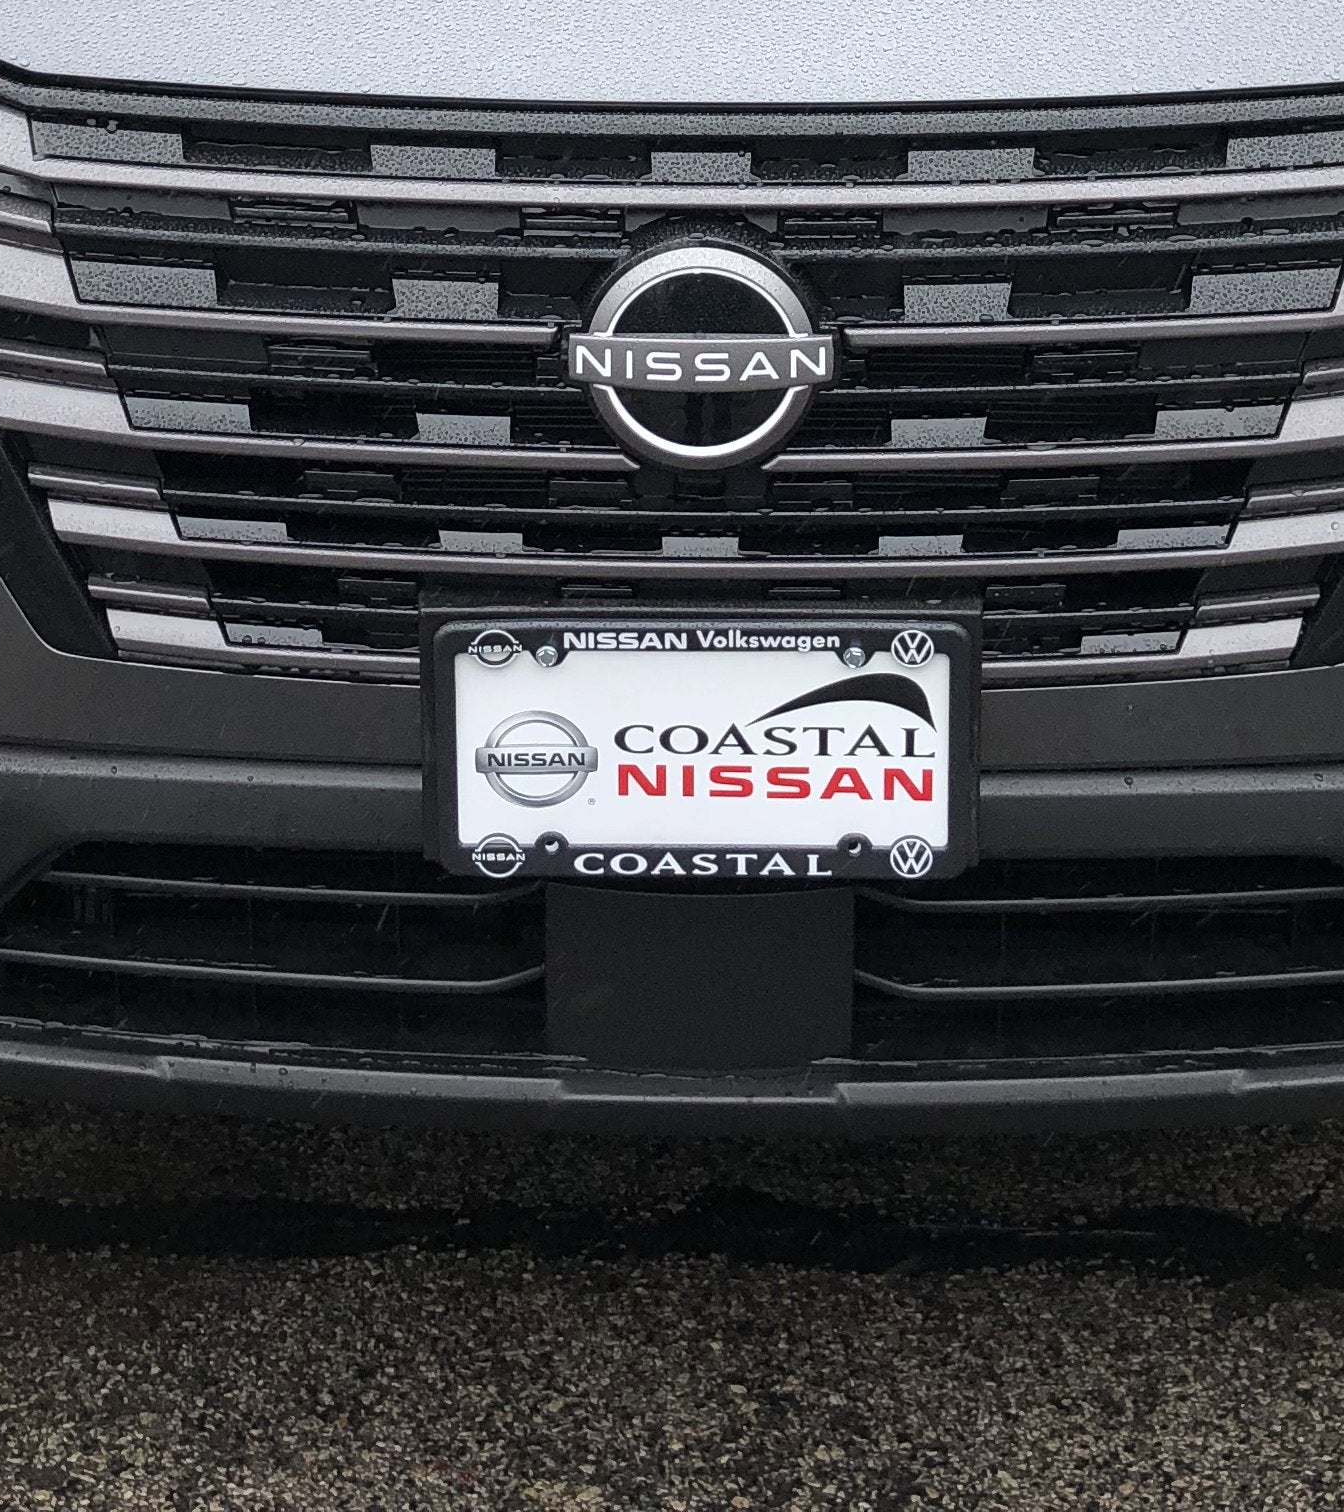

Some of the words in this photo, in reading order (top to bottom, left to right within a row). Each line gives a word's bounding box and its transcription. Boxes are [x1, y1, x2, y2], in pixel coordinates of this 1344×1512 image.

[575, 344, 827, 382] NISSAN
[468, 644, 522, 654] NISSAN
[562, 631, 688, 650] NISSAN
[695, 630, 841, 652] Volkswagen
[613, 722, 937, 758] COASTAL
[486, 750, 586, 769] NISSAN
[617, 764, 934, 802] NISSAN
[472, 852, 525, 861] NISSAN
[573, 852, 833, 877] COASTAL
